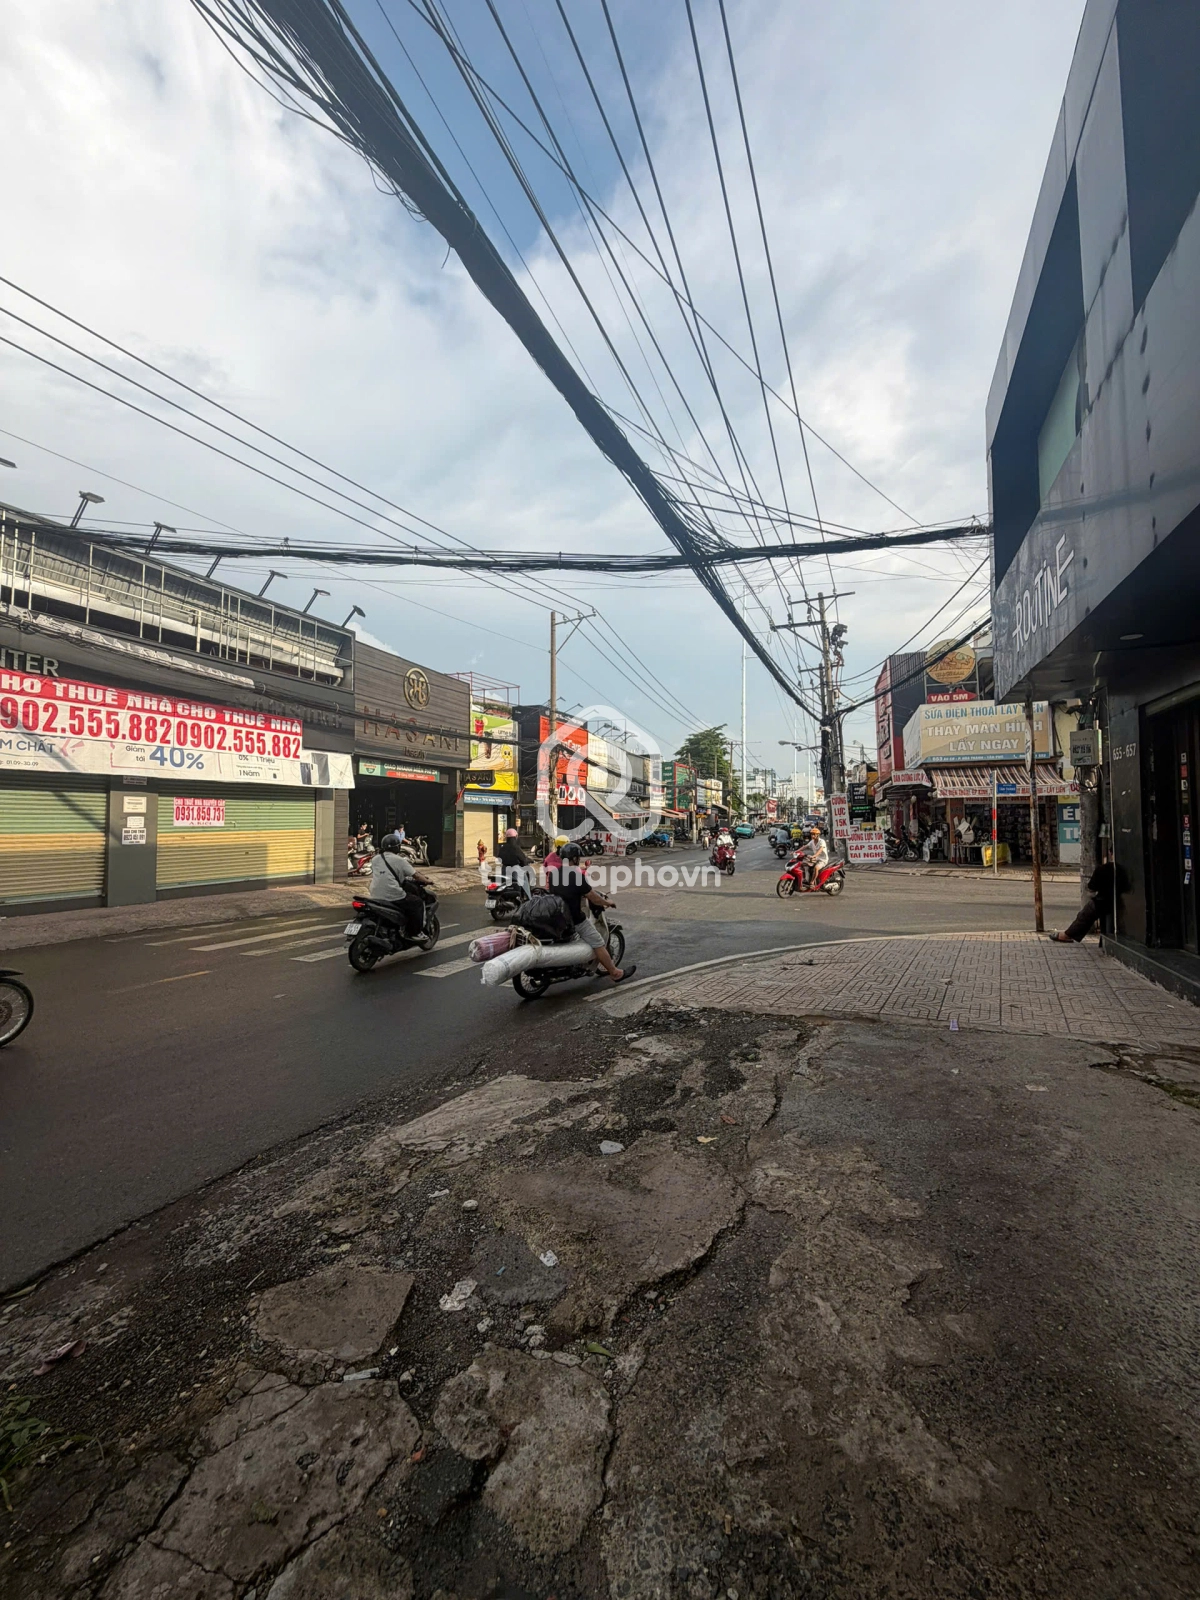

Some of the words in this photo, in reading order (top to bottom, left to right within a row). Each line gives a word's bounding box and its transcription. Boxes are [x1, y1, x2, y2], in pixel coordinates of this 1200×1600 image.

[1012, 533, 1074, 652] ROUTINE
[52, 681, 118, 705] THUÊ
[127, 693, 172, 713] NHÀ
[953, 693, 968, 701] 5M
[176, 702, 216, 720] CHO
[223, 709, 266, 728] THUÊ
[270, 718, 301, 734] NHÀ
[927, 725, 961, 737] THAY
[966, 721, 1000, 735] MÀN
[16, 737, 56, 754] CHẤT
[175, 720, 301, 759] 0902.555.882
[980, 739, 1019, 751] NGAY
[149, 746, 205, 770] 40%
[176, 806, 224, 822] 0931.859.731
[836, 818, 847, 828] 15K
[835, 829, 850, 838] FULL
